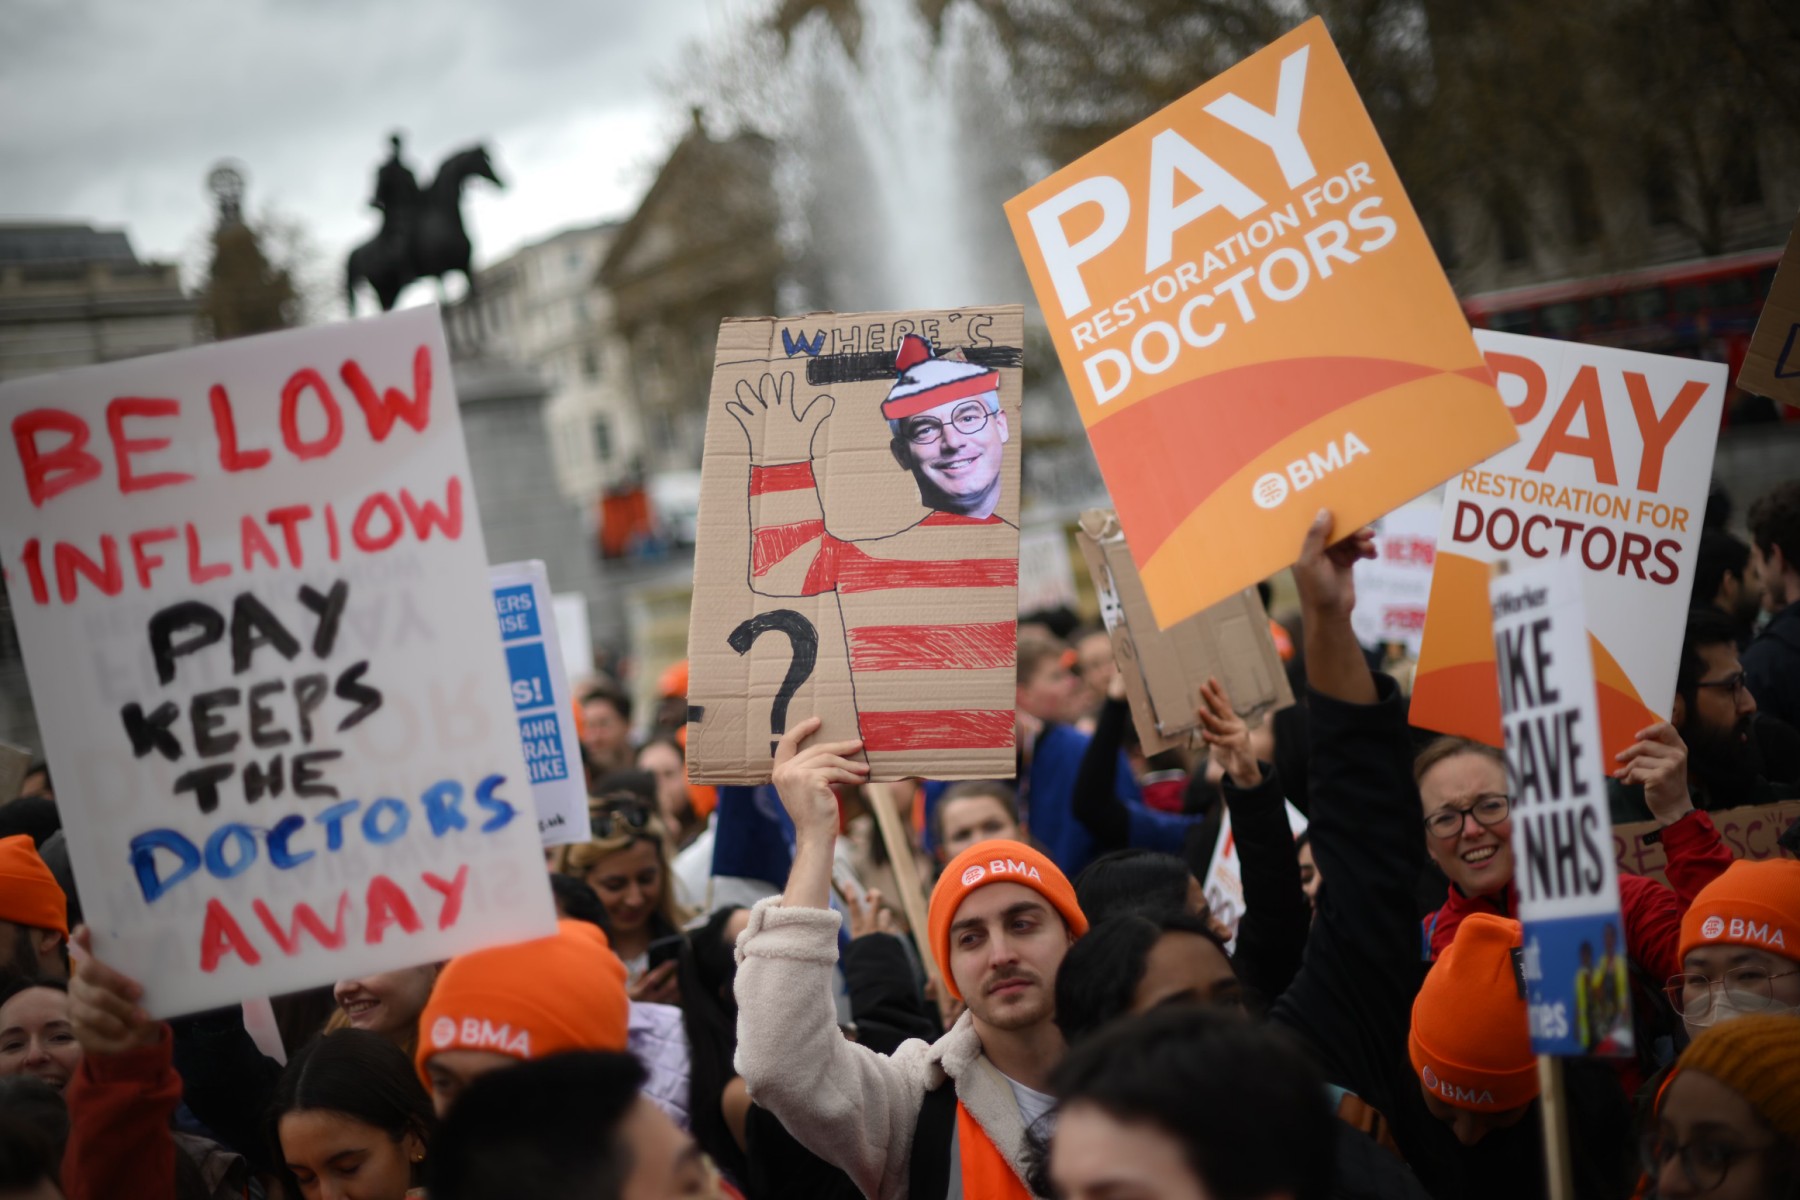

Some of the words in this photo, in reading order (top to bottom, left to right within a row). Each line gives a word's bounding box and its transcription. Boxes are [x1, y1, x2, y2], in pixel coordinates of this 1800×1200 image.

[1027, 44, 1318, 320] PAY
[1071, 203, 1300, 351] RESTORATION
[1302, 161, 1376, 218] FOR
[1083, 196, 1397, 406] DOCTORS
[781, 313, 993, 357] WHERE'S
[11, 344, 432, 508] BELOW
[1286, 432, 1370, 491] BMA
[1484, 350, 1710, 493] PAY
[1452, 499, 1683, 585] DOCTORS
[1461, 469, 1631, 521] RESTORATION
[1636, 501, 1689, 533] FOR
[148, 579, 349, 687] PAY
[120, 660, 383, 762] KEEPS
[174, 750, 344, 815] THE
[129, 774, 520, 905] DOCTORS
[990, 859, 1042, 883] BMA
[1523, 804, 1604, 900] NHS
[199, 864, 470, 974] AWAY
[1729, 918, 1786, 949] BMA
[460, 1017, 532, 1058] BMA
[1440, 1079, 1495, 1105] BMA
